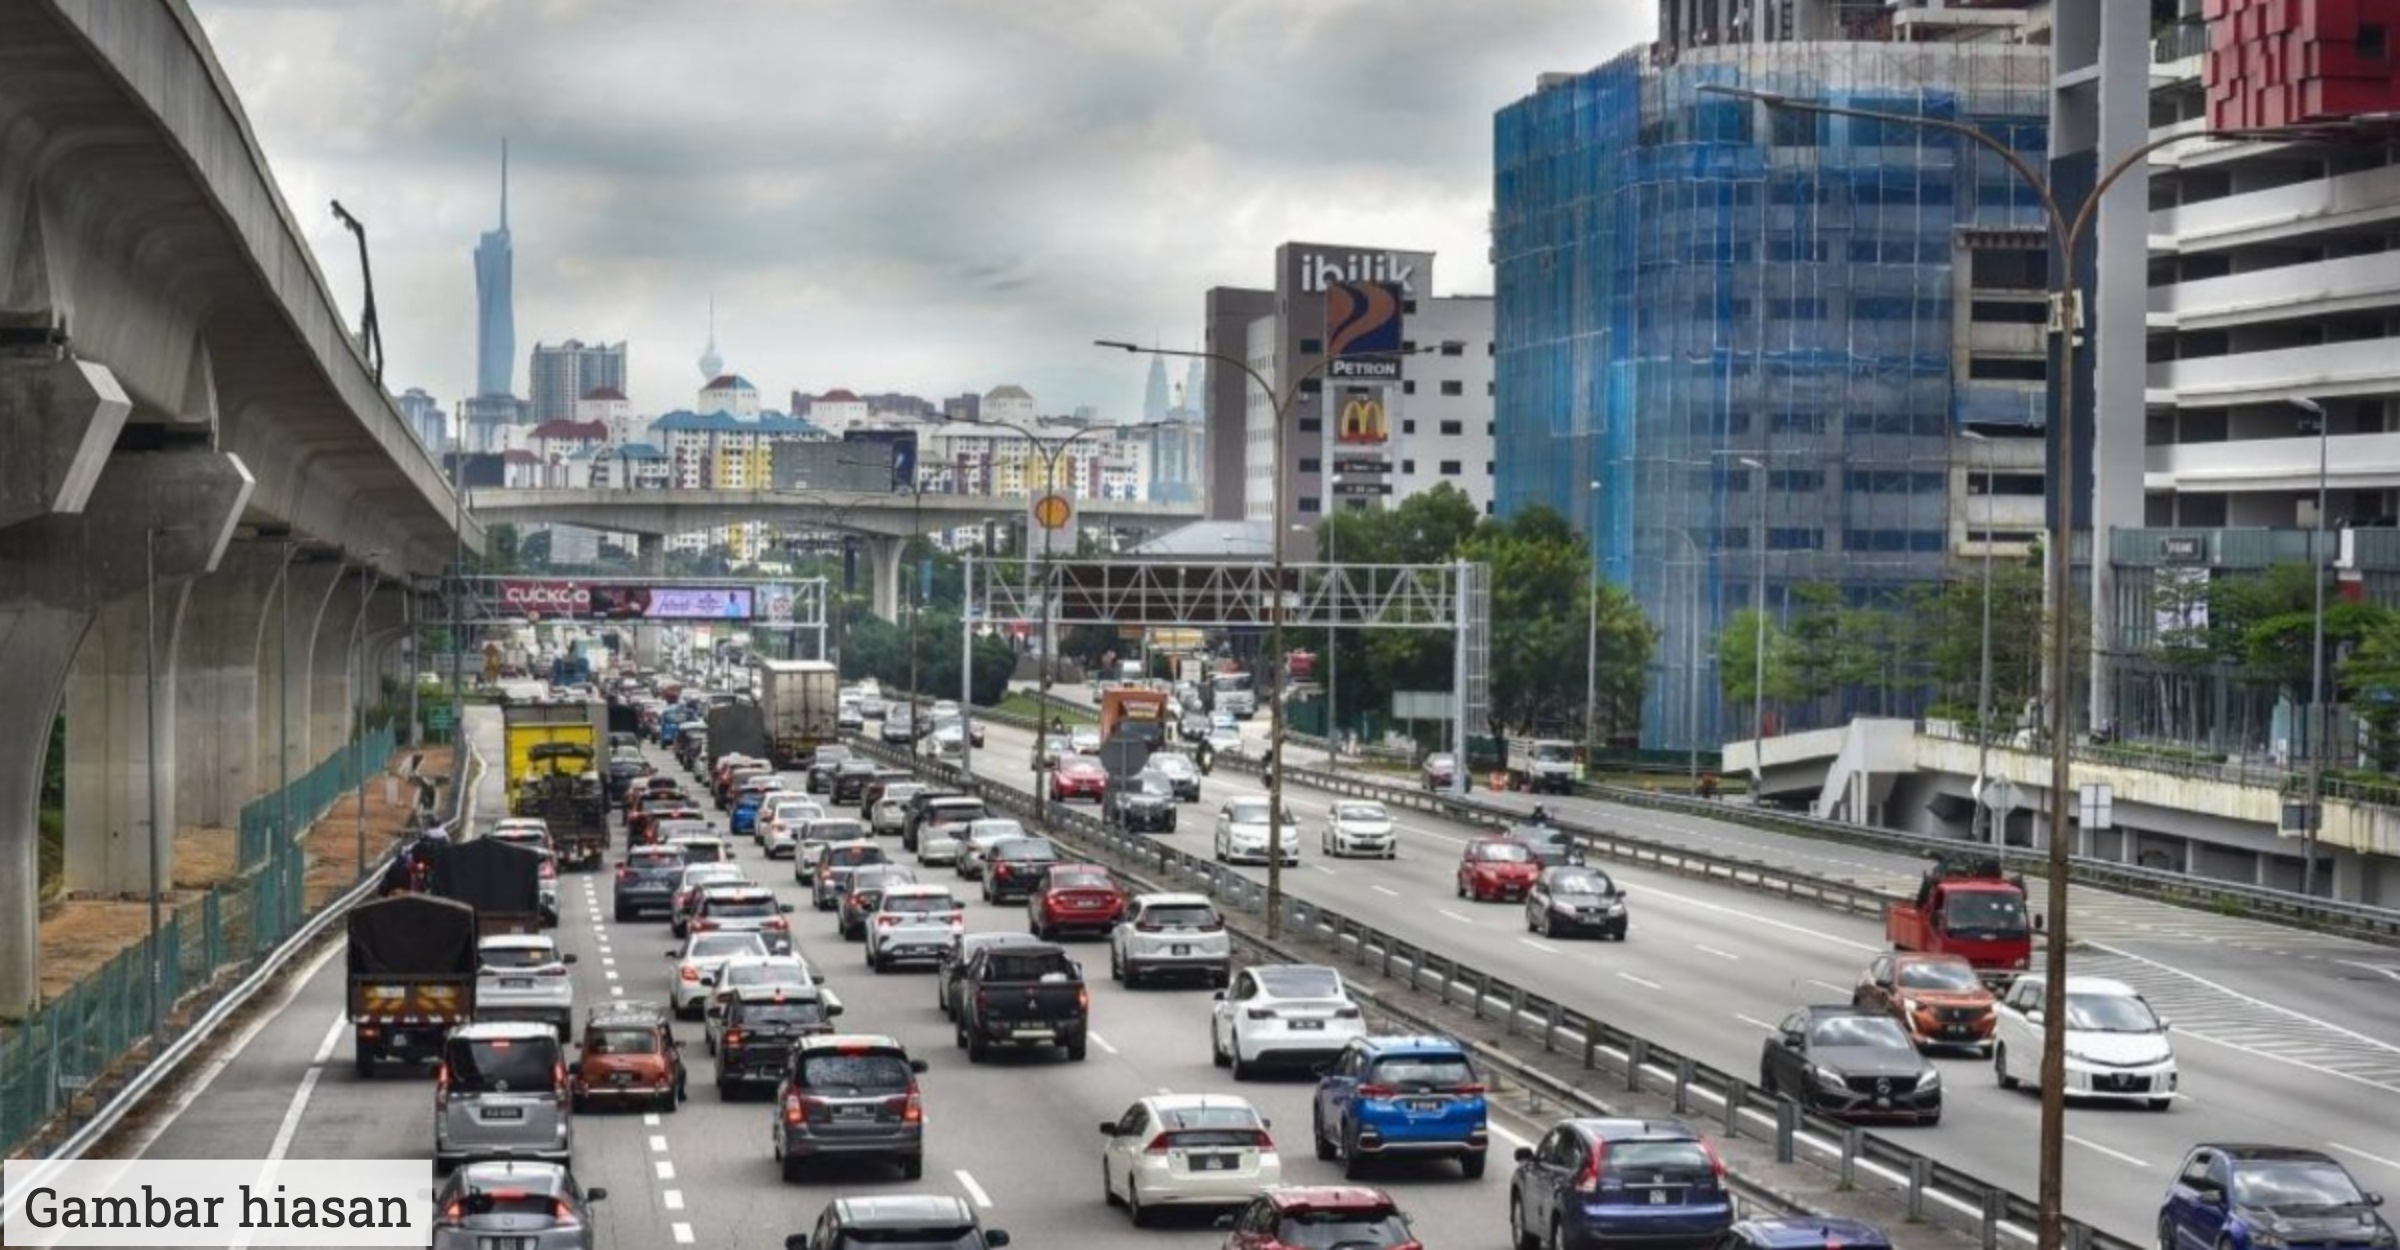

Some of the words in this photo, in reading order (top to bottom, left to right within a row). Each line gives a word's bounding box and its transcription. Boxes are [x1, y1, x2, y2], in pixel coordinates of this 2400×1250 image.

[1301, 254, 1413, 292] ibilik
[1333, 360, 1396, 375] PETRON
[506, 587, 591, 603] CUCKOO
